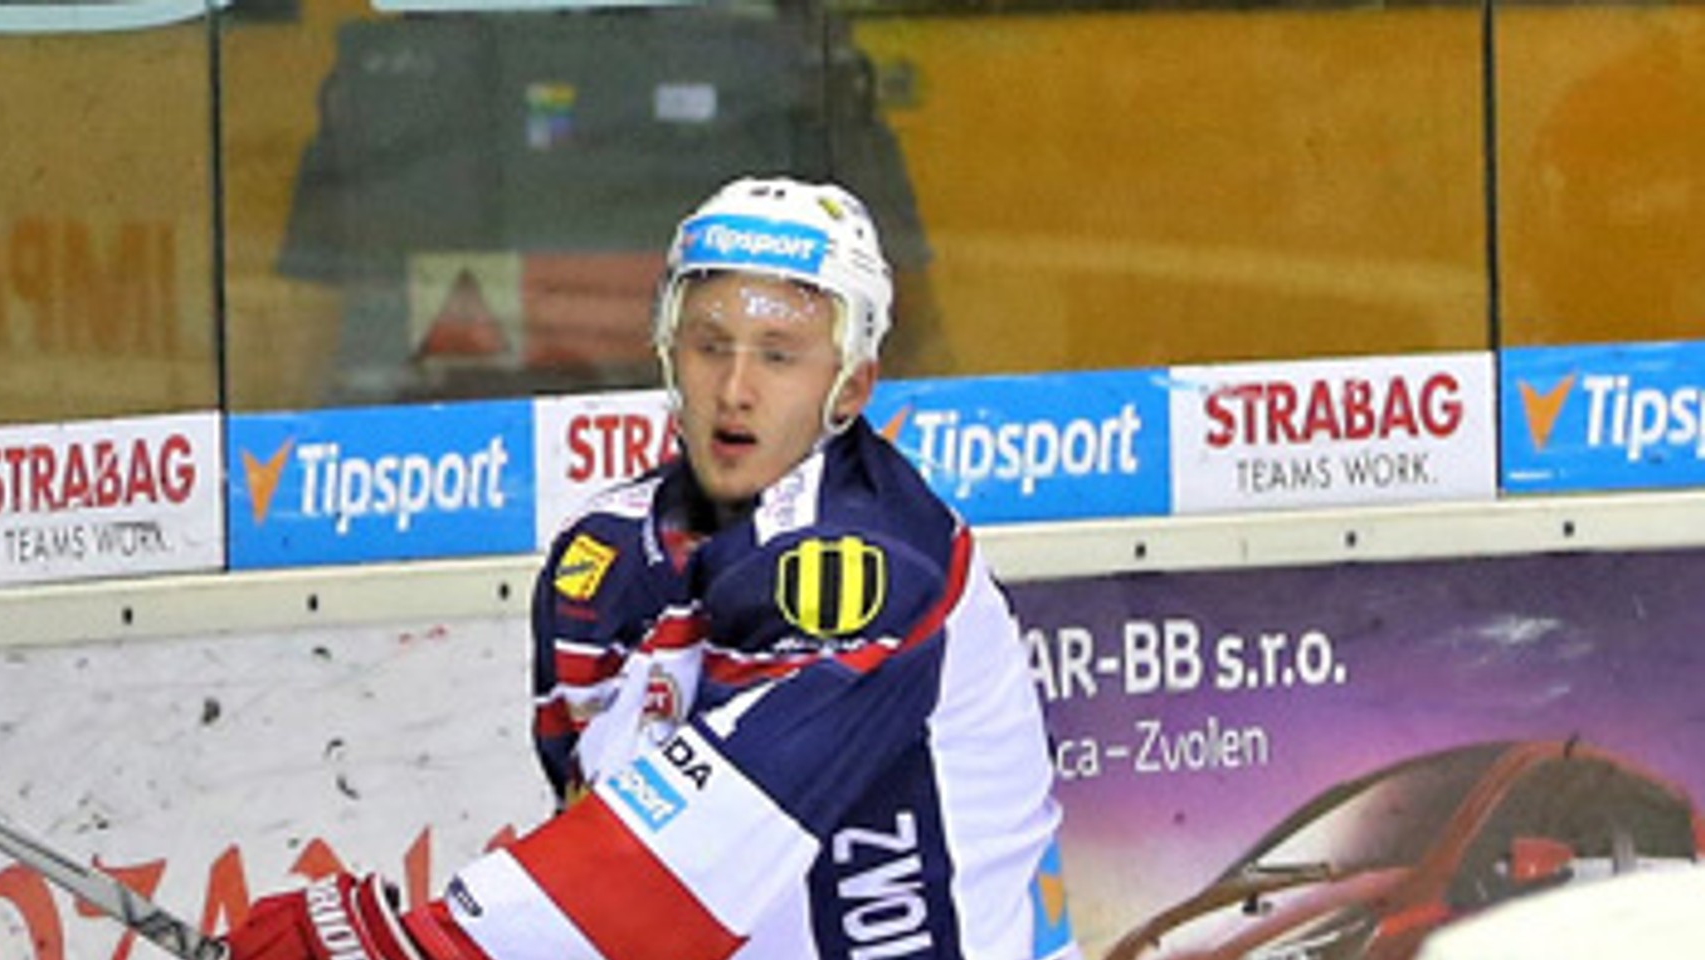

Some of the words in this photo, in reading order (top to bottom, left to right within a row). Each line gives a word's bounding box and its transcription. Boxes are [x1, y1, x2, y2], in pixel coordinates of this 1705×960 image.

[705, 224, 817, 260] Tipsport
[1205, 373, 1464, 448] STRABAG
[1583, 374, 1705, 463] Tips
[297, 435, 508, 534] Tipsport
[914, 404, 1141, 498] Tipsport
[1237, 456, 1332, 493] TEAMS
[4, 526, 86, 564] TEAMS
[1216, 630, 1347, 690] s.r.o.
